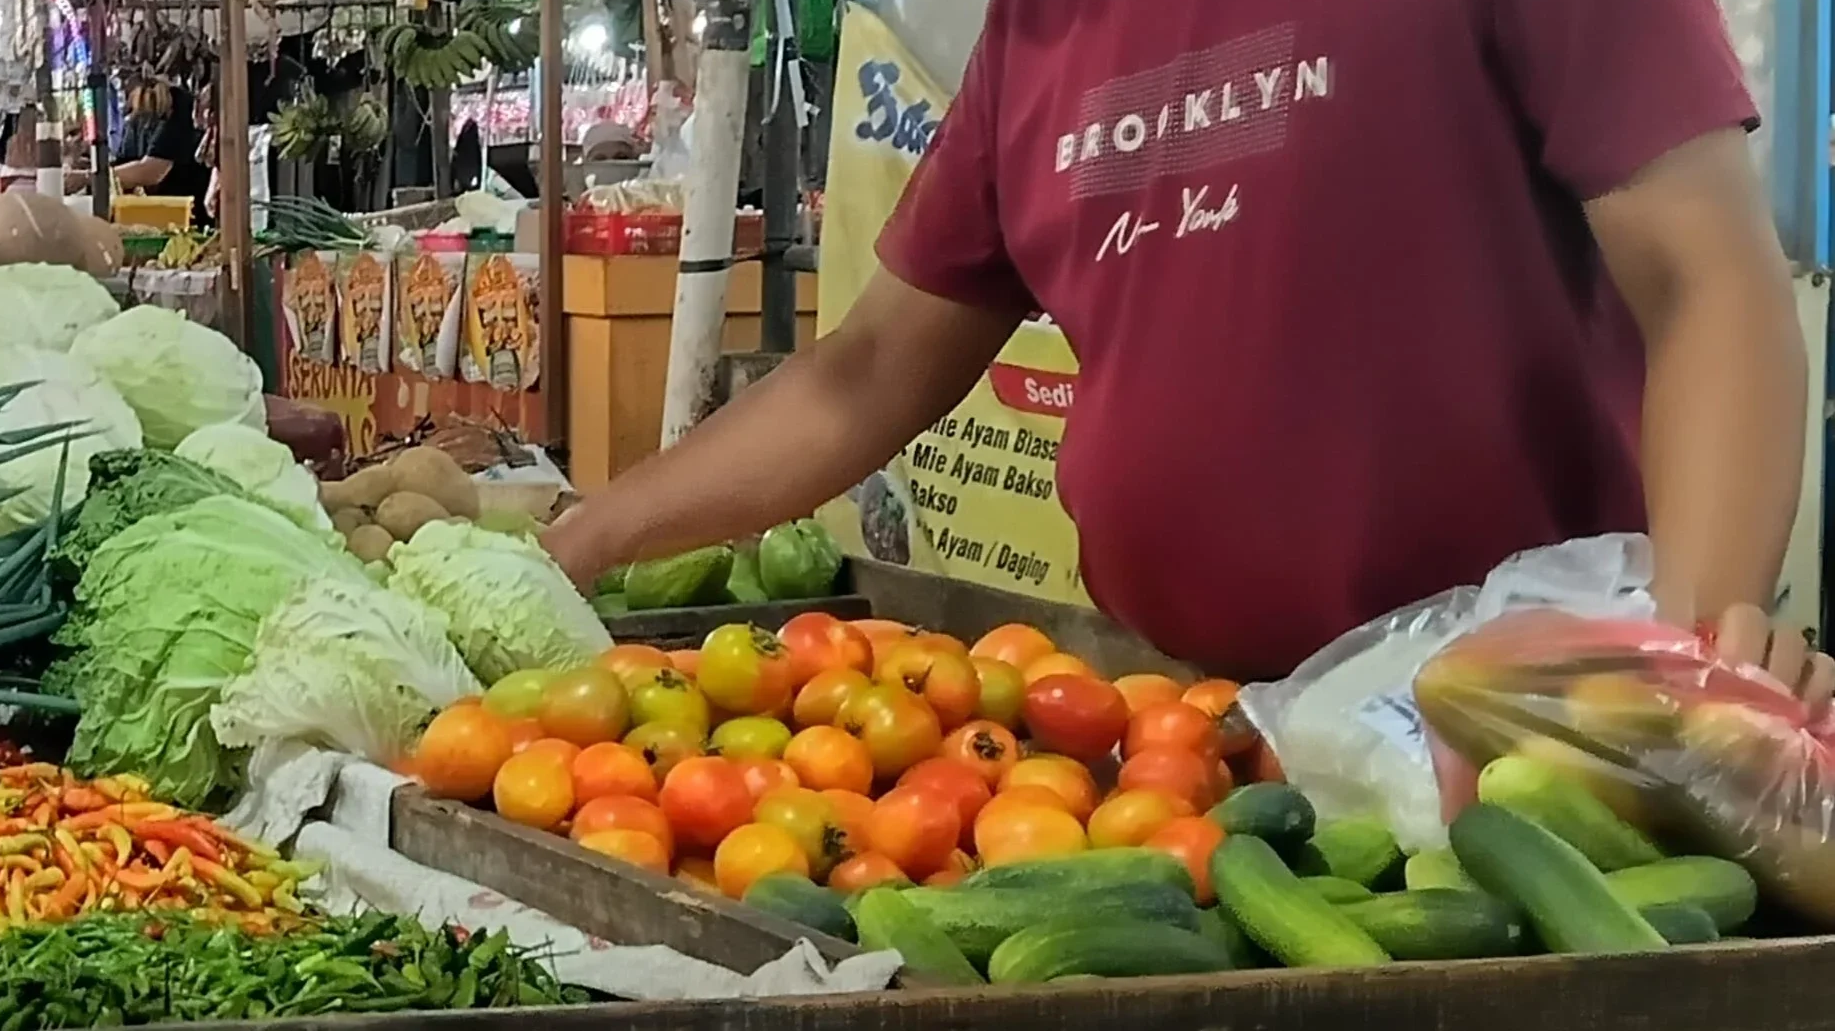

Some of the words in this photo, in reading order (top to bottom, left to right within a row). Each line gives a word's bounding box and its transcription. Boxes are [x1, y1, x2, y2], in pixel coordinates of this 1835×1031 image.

[1175, 183, 1240, 239] York
[961, 417, 1011, 451] Ayam
[1013, 428, 1060, 462] Biasa
[910, 479, 959, 516] Bakso
[913, 442, 948, 474] Mie
[950, 453, 1000, 489] Ayam
[1003, 465, 1053, 501] Bakso
[936, 526, 985, 560] Ayam
[996, 543, 1051, 586] Daging
